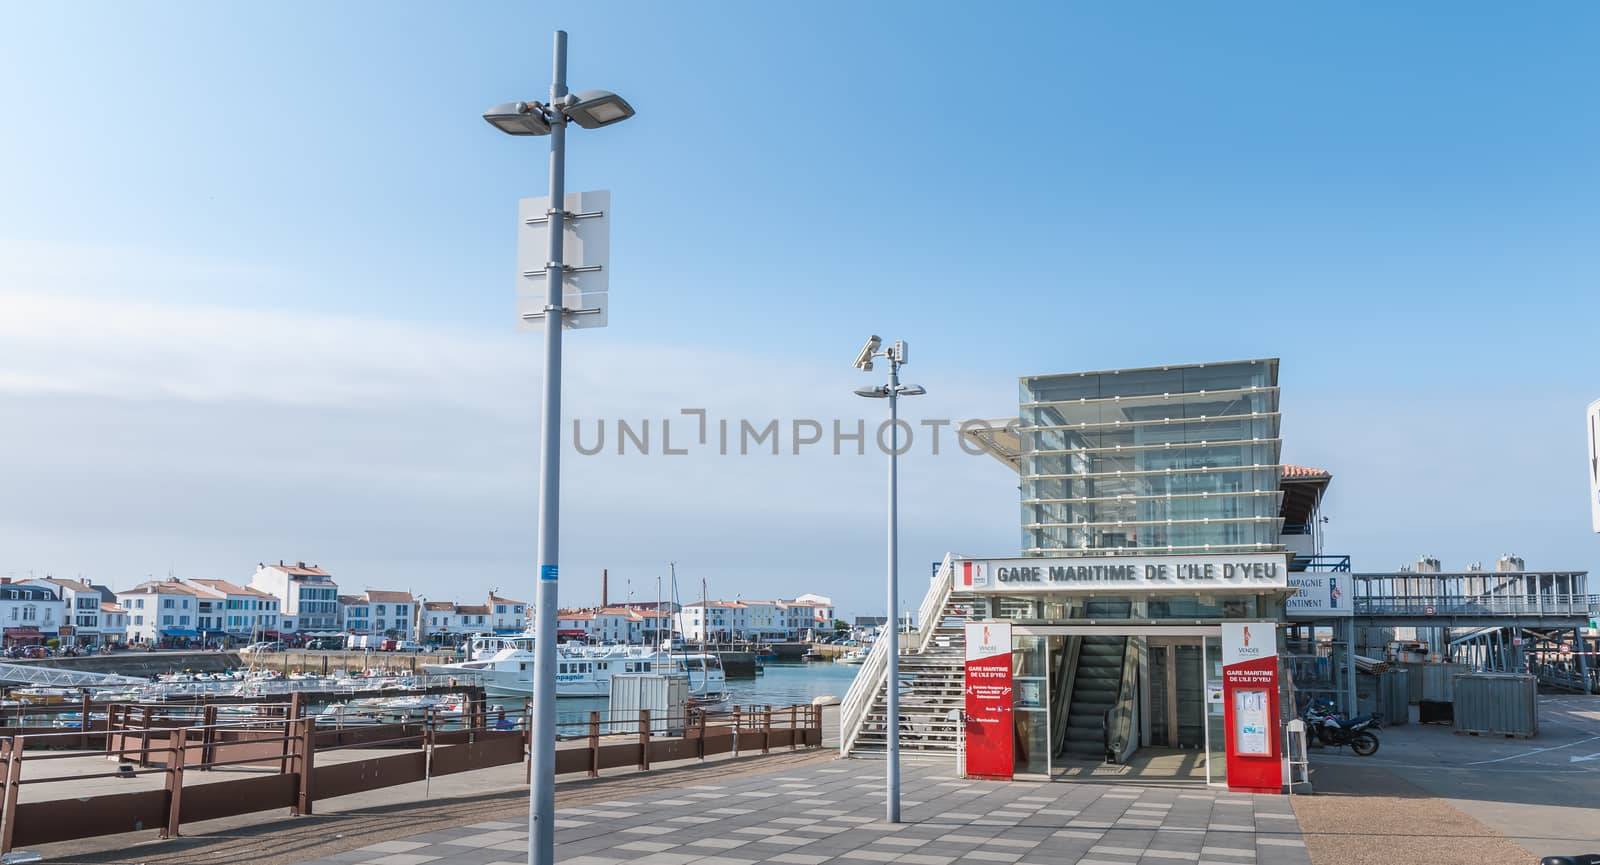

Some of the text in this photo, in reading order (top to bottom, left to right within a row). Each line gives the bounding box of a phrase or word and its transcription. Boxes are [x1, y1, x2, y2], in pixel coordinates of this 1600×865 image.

[998, 562, 1276, 582] GARE MARITIME DE L'ILE D'YEU
[1288, 578, 1322, 587] MPAGNIE
[1286, 599, 1322, 608] ONTINENT
